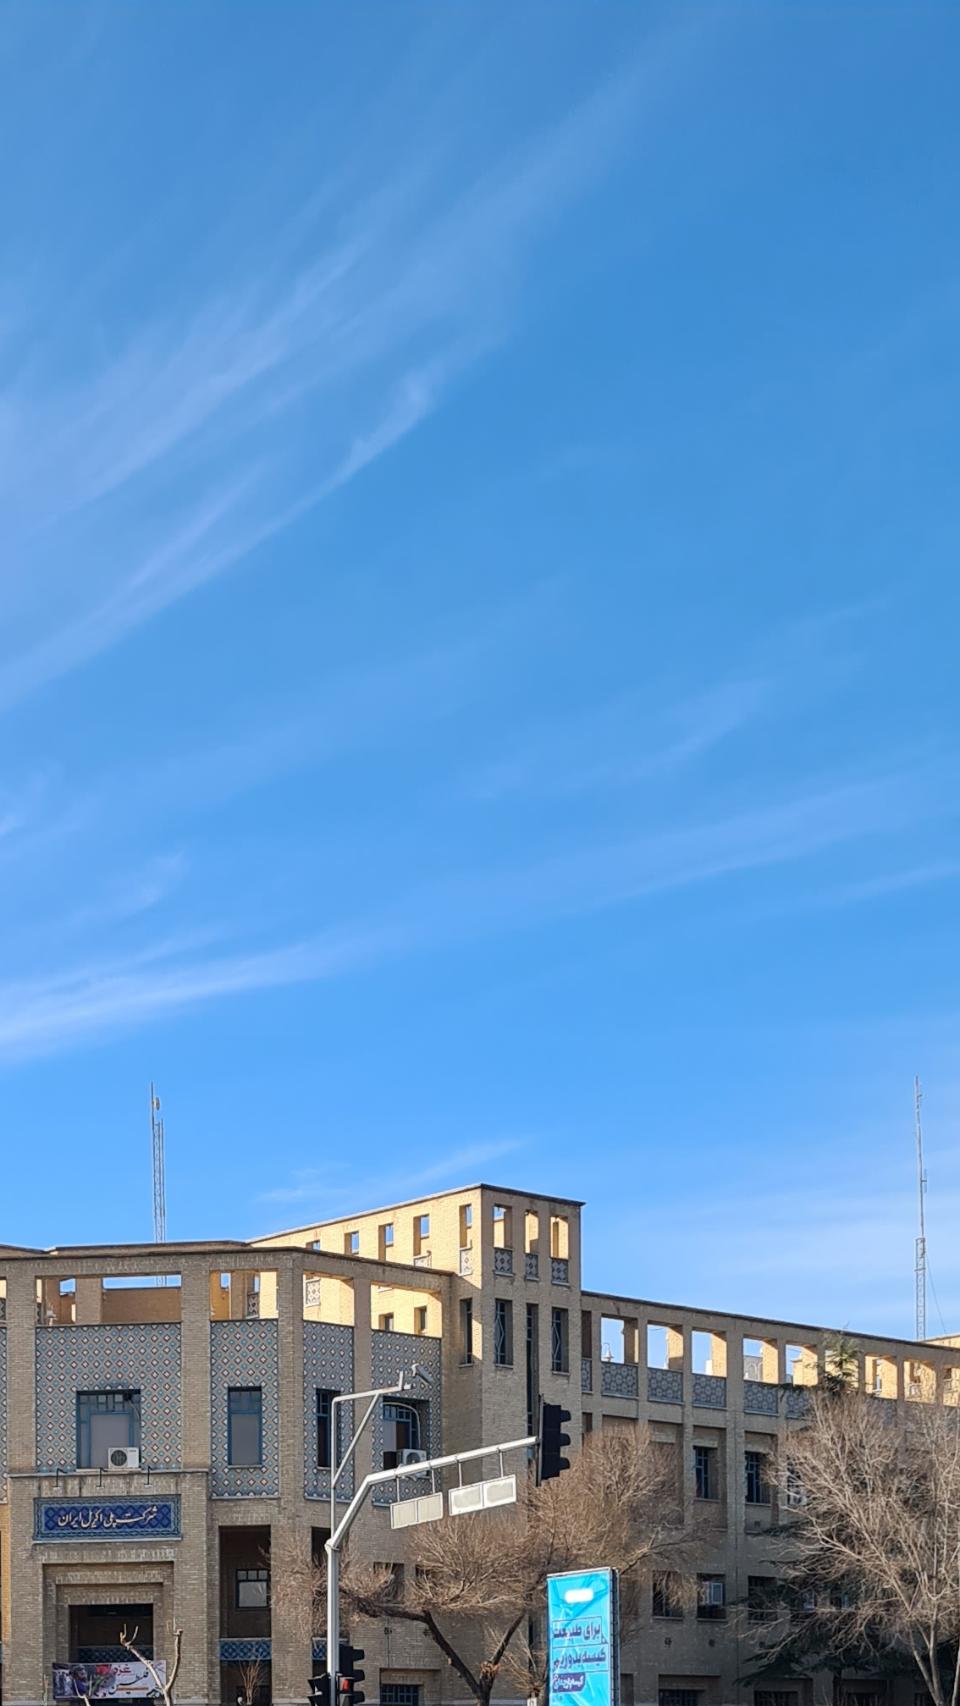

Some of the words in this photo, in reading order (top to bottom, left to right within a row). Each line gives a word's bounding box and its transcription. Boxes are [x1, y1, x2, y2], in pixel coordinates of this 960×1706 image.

[57, 1513, 82, 1527] ایران
[103, 1511, 117, 1528] پلی
[115, 1504, 158, 1525] شرکت
[583, 1622, 601, 1640] برای
